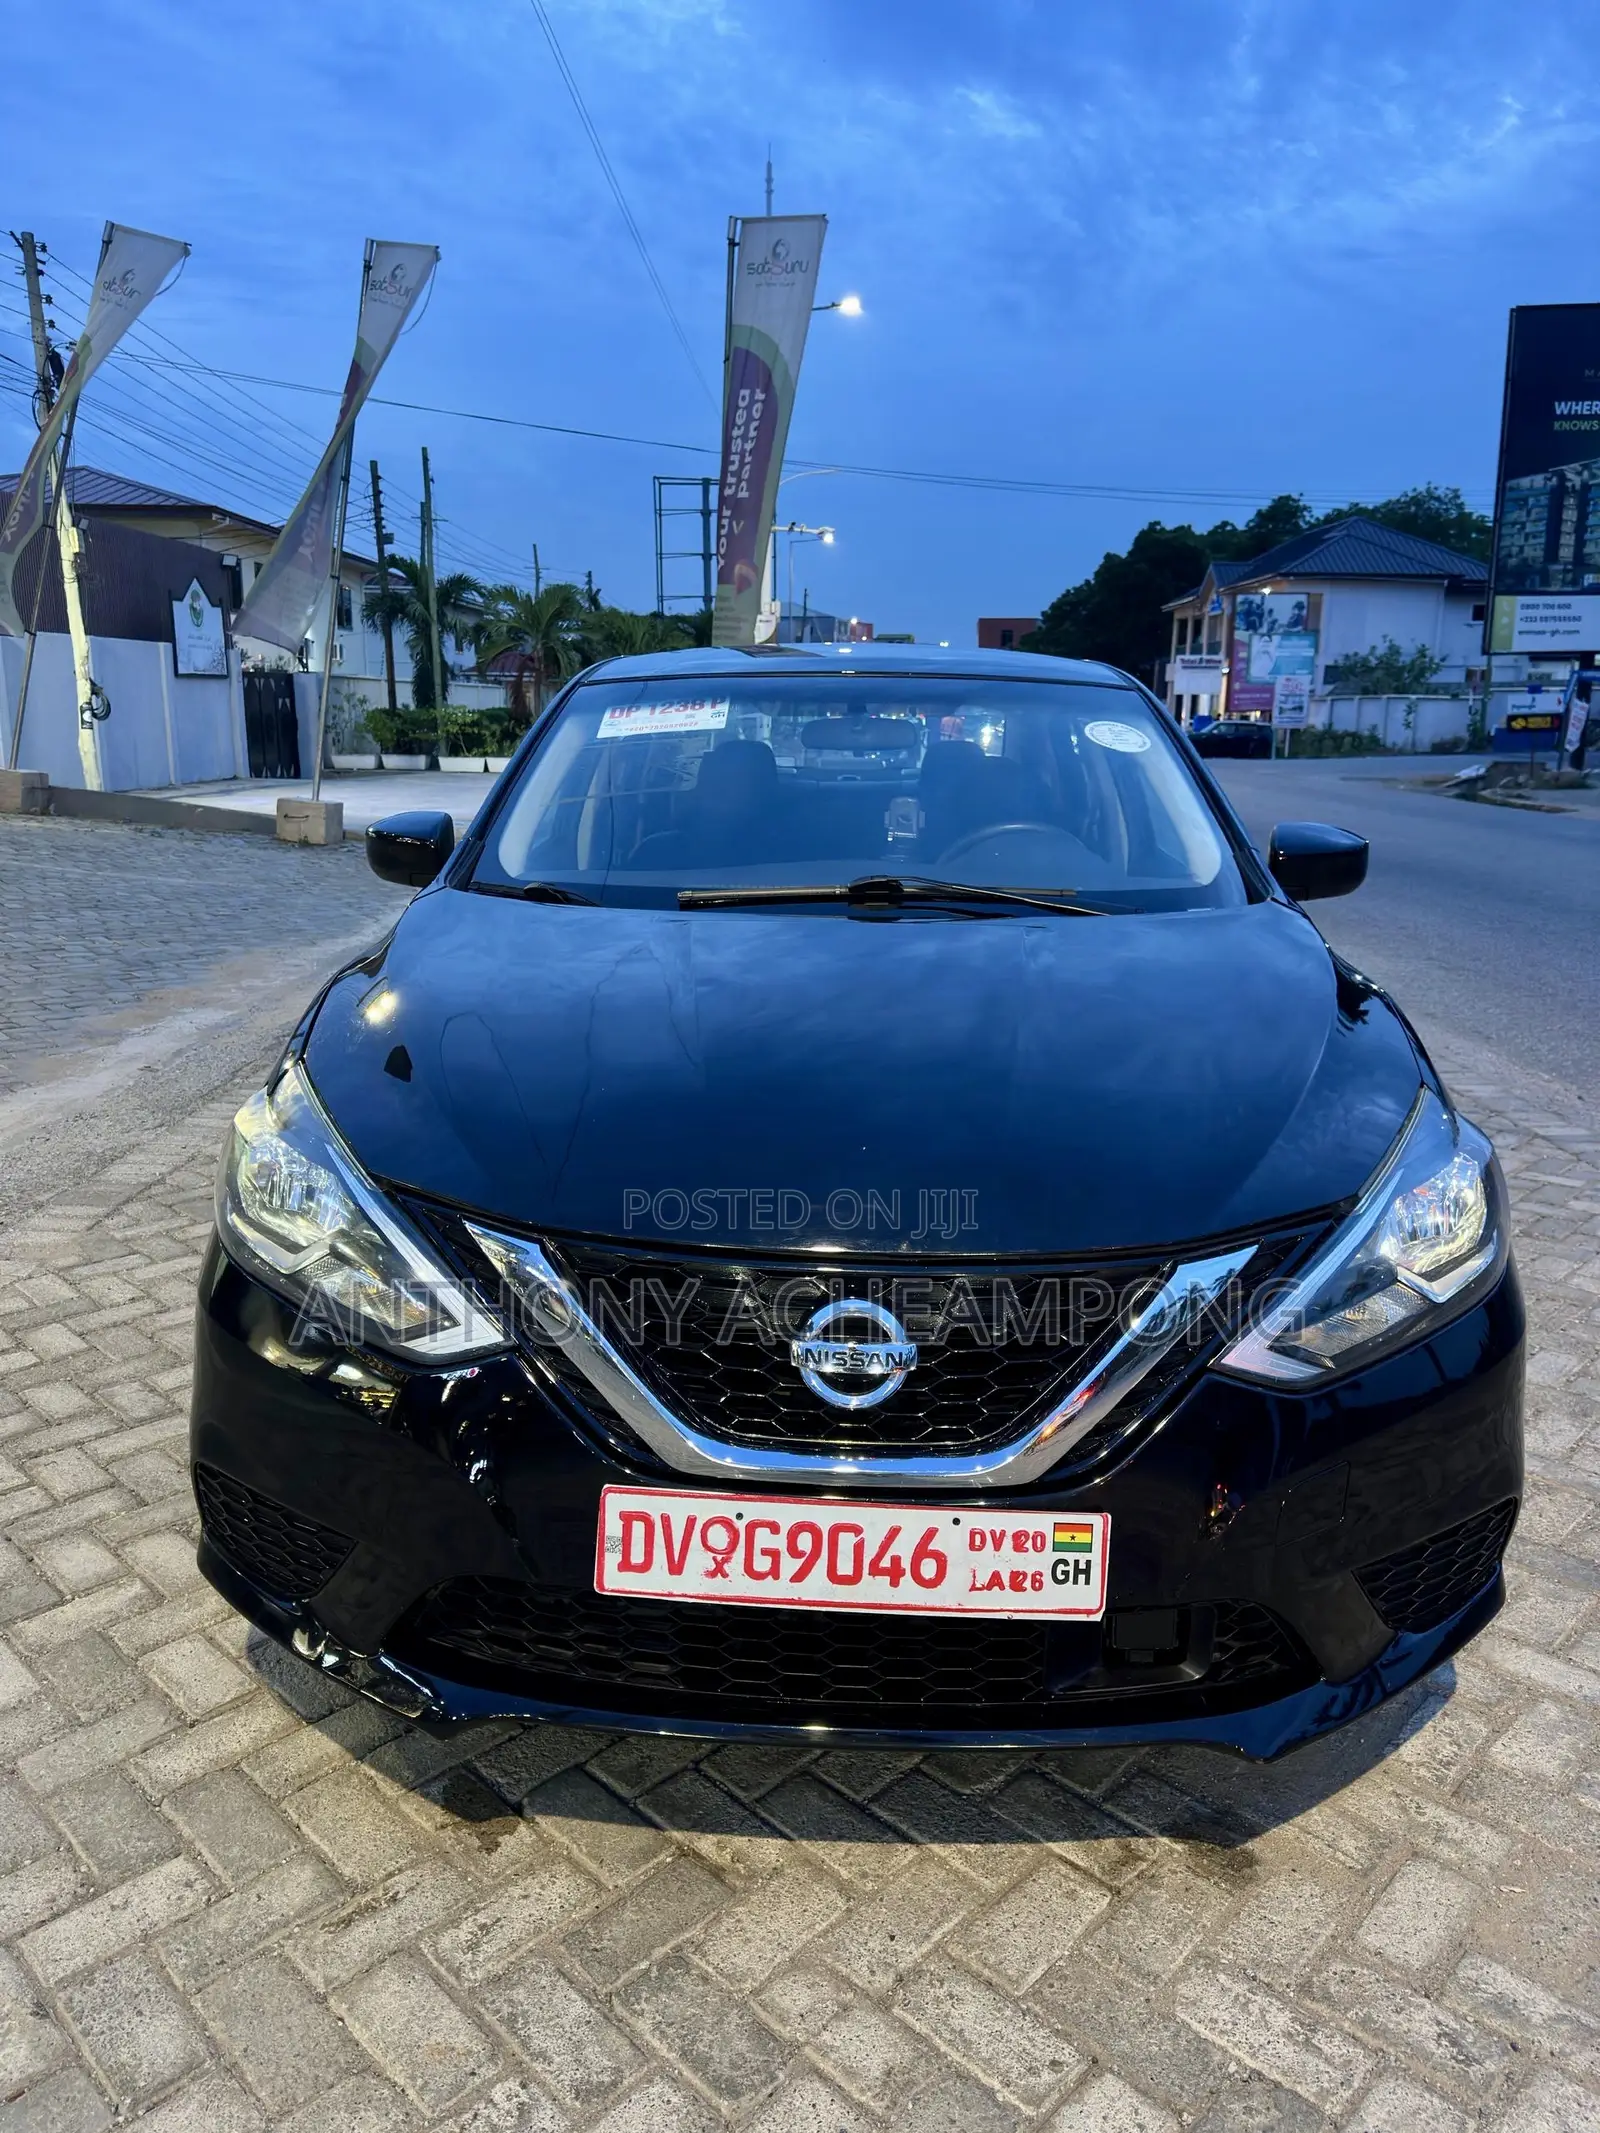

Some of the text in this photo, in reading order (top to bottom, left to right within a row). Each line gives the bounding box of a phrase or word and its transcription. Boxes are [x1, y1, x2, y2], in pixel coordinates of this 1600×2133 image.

[1554, 420, 1600, 431] KNOWS
[609, 703, 641, 719] DP
[804, 1348, 903, 1368] NISSAN
[1051, 1558, 1092, 1586] GH
